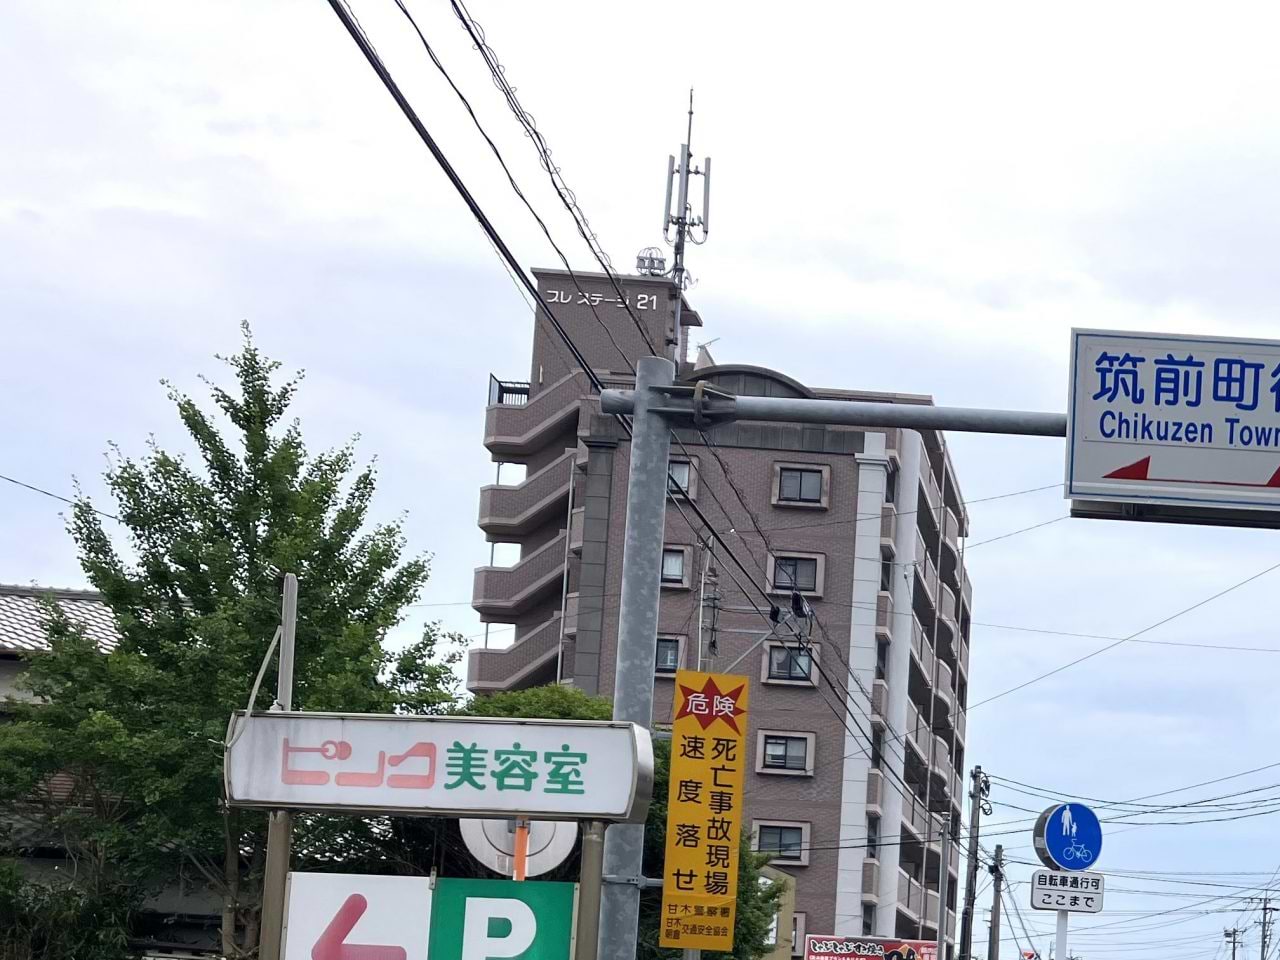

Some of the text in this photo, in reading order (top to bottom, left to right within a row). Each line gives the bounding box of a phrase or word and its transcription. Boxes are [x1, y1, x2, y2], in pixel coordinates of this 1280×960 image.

[1099, 409, 1213, 444] Chikuzen
[685, 693, 736, 718] 危険
[672, 734, 706, 892] 速度落せ
[704, 737, 737, 896] 死亡事故現場
[1037, 874, 1100, 890] 自転車通行可
[1041, 893, 1095, 908] ここまで
